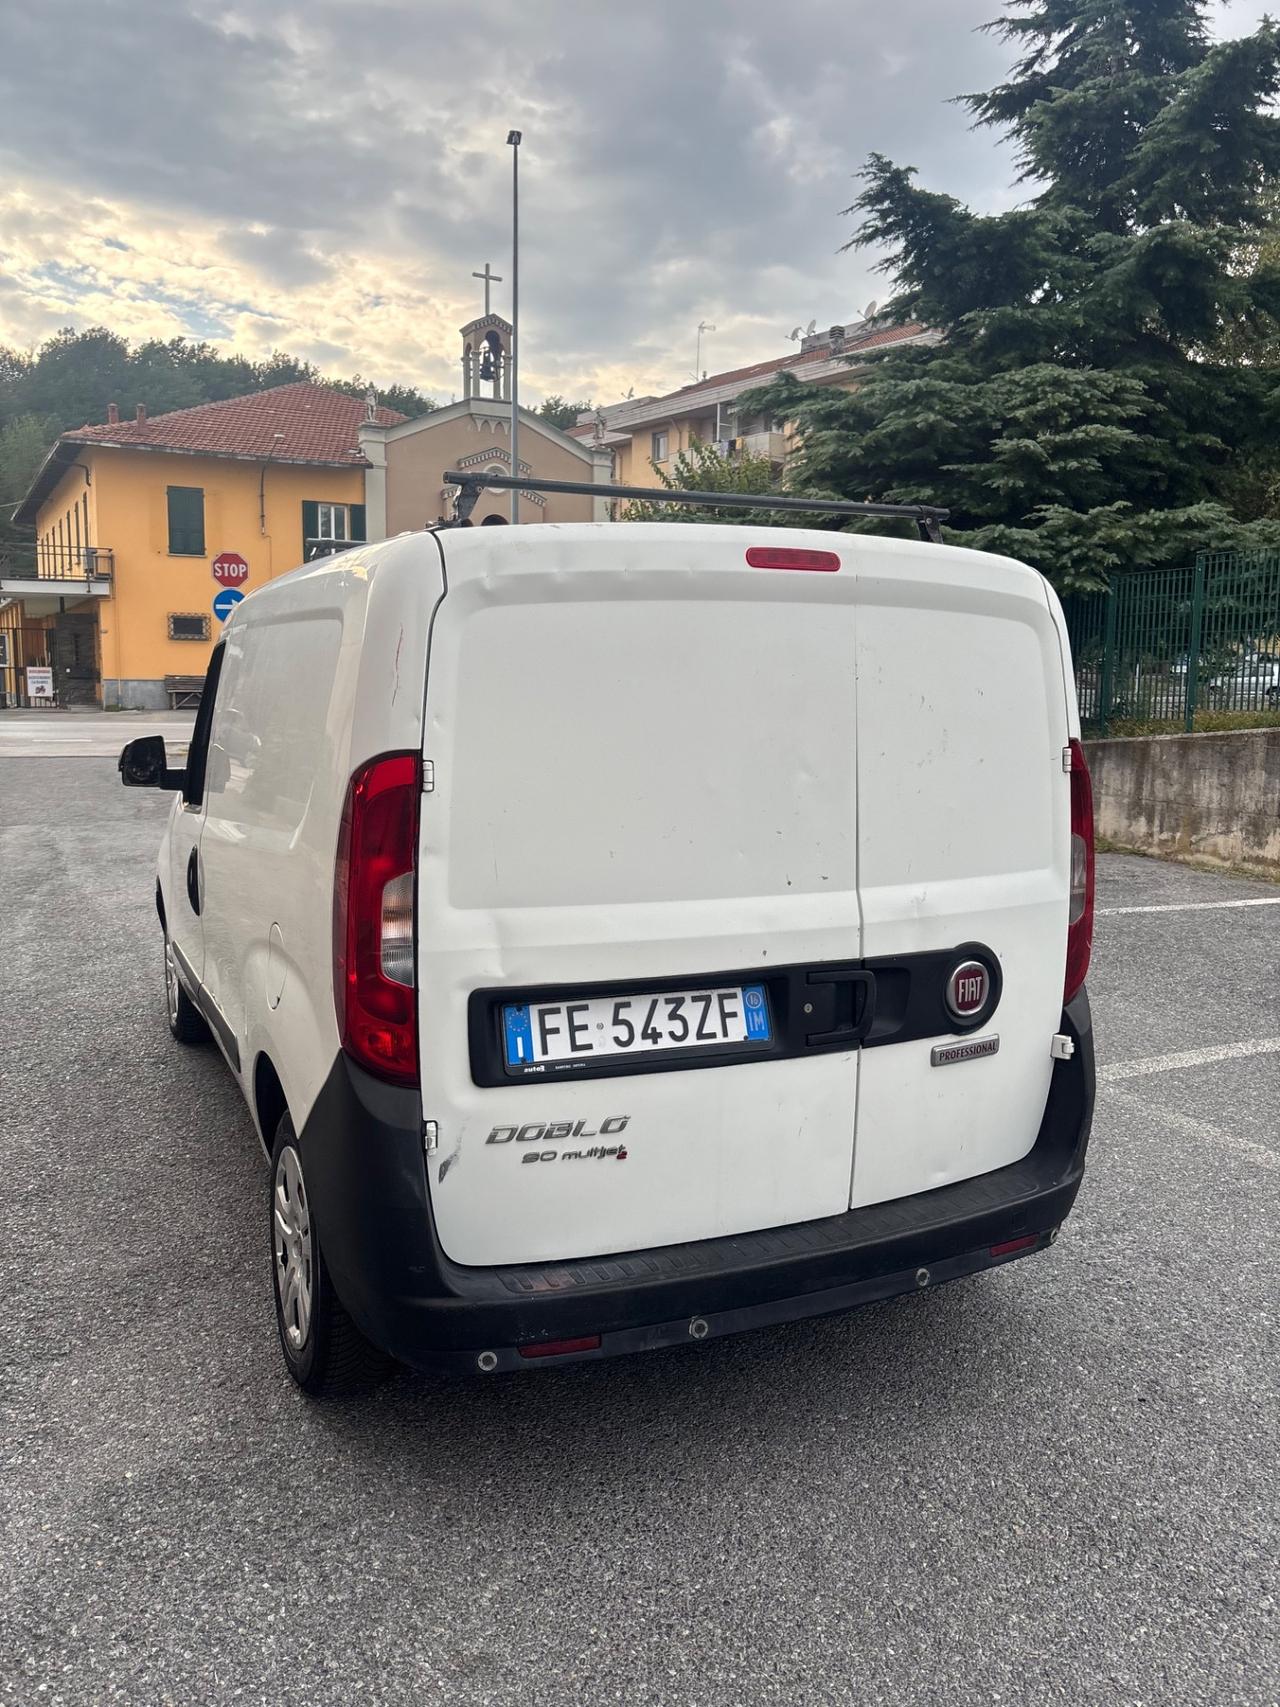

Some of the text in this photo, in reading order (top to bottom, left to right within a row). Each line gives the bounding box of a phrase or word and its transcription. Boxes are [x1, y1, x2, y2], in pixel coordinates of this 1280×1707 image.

[214, 563, 247, 577] STOP
[958, 976, 983, 1003] FIAT
[538, 992, 739, 1056] FE 543ZF
[748, 1010, 765, 1032] IM
[939, 1041, 997, 1061] PROFESSIONAL
[522, 1151, 557, 1164] 90
